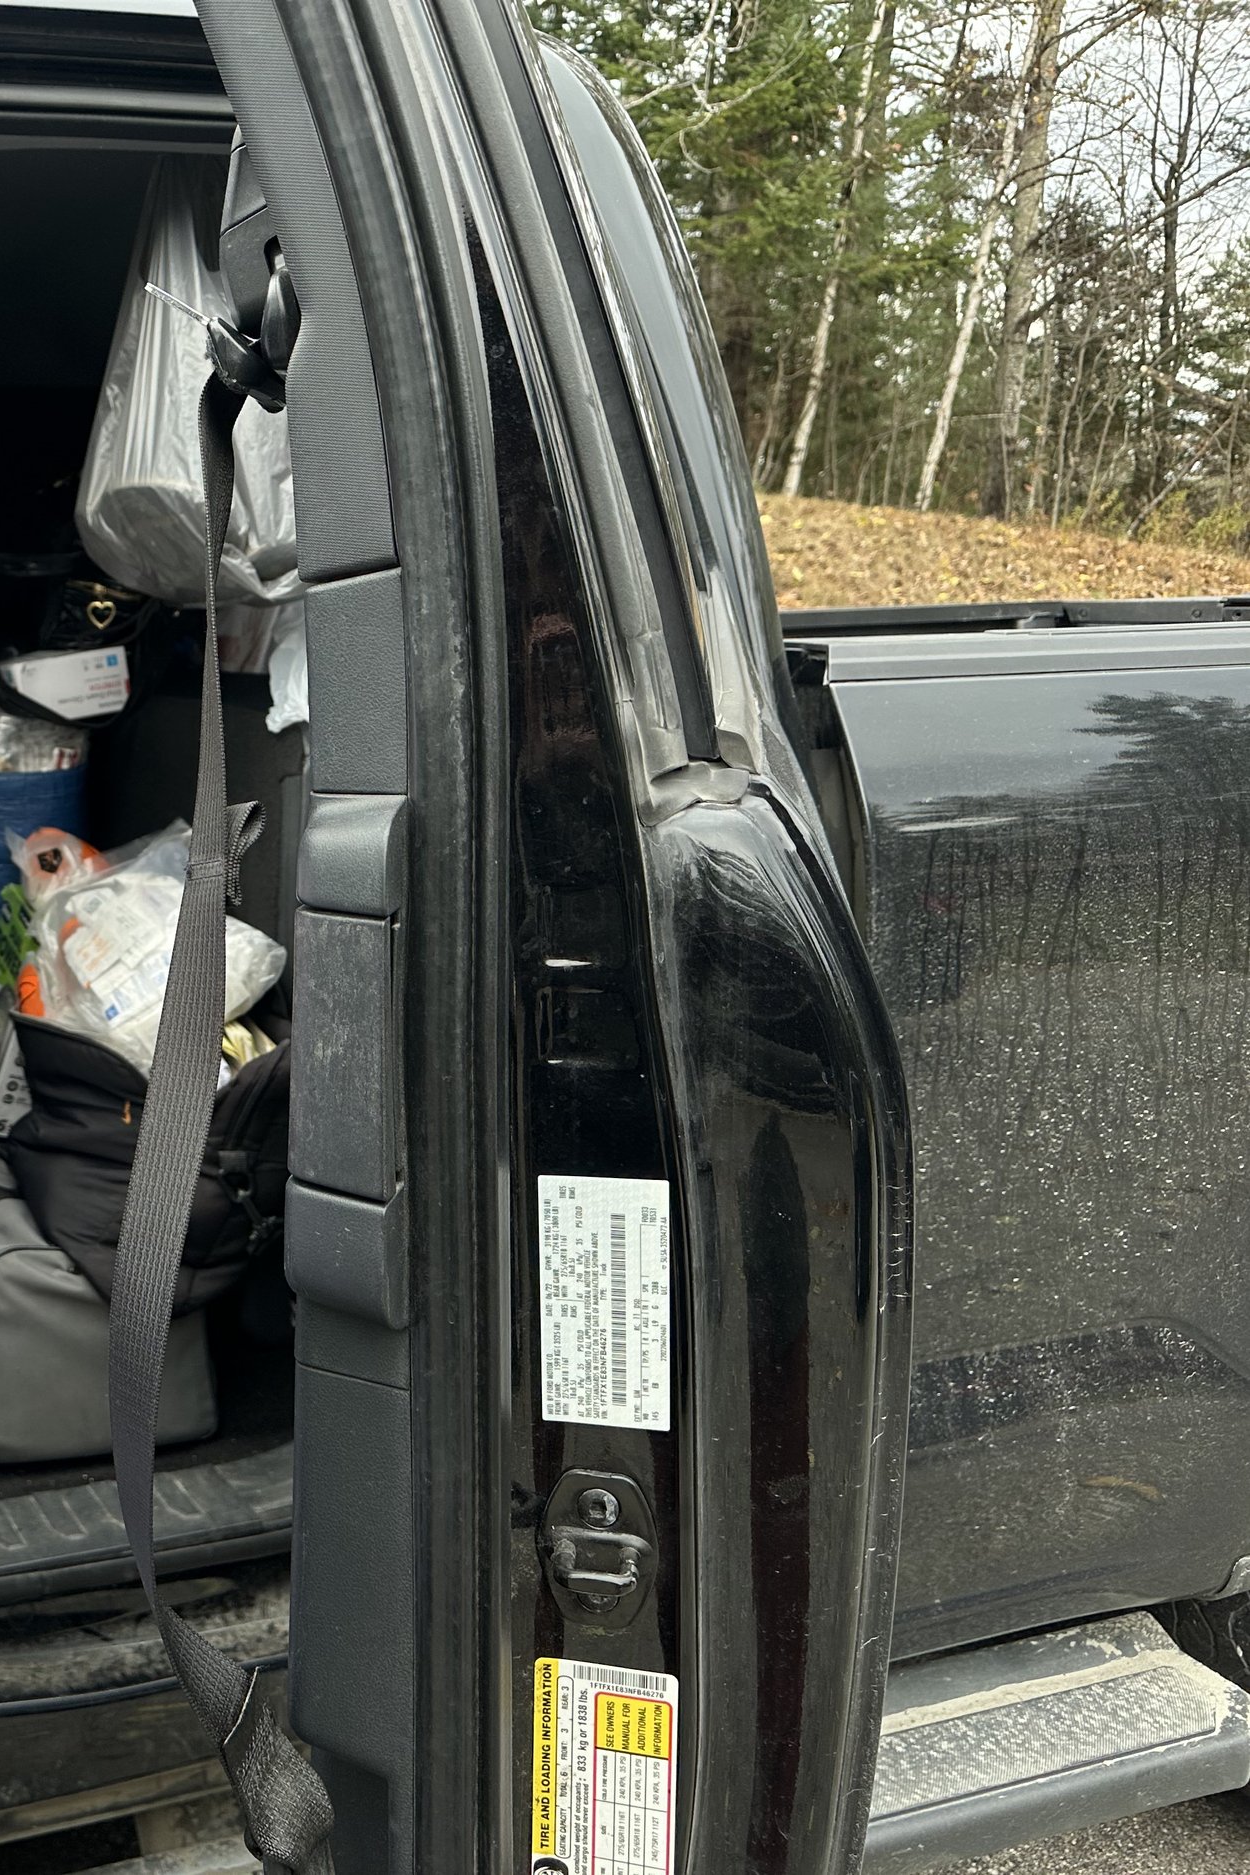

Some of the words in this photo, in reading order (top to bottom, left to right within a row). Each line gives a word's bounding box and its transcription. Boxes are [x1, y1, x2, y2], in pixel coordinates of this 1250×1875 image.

[542, 1663, 551, 1740] INFORMATION
[578, 1689, 587, 1702] lbs.
[578, 1705, 587, 1725] 1838
[622, 1703, 630, 1717] FOR
[580, 1729, 587, 1737] or
[622, 1720, 630, 1750] MANUAL
[638, 1707, 646, 1751] ADDITIONAL
[654, 1704, 662, 1755] INFORMATION
[578, 1741, 588, 1751] kg
[606, 1734, 614, 1747] SEE
[542, 1744, 550, 1793] LOADING
[577, 1756, 586, 1772] 833
[541, 1797, 549, 1820] AND
[541, 1823, 549, 1848] TIRE
